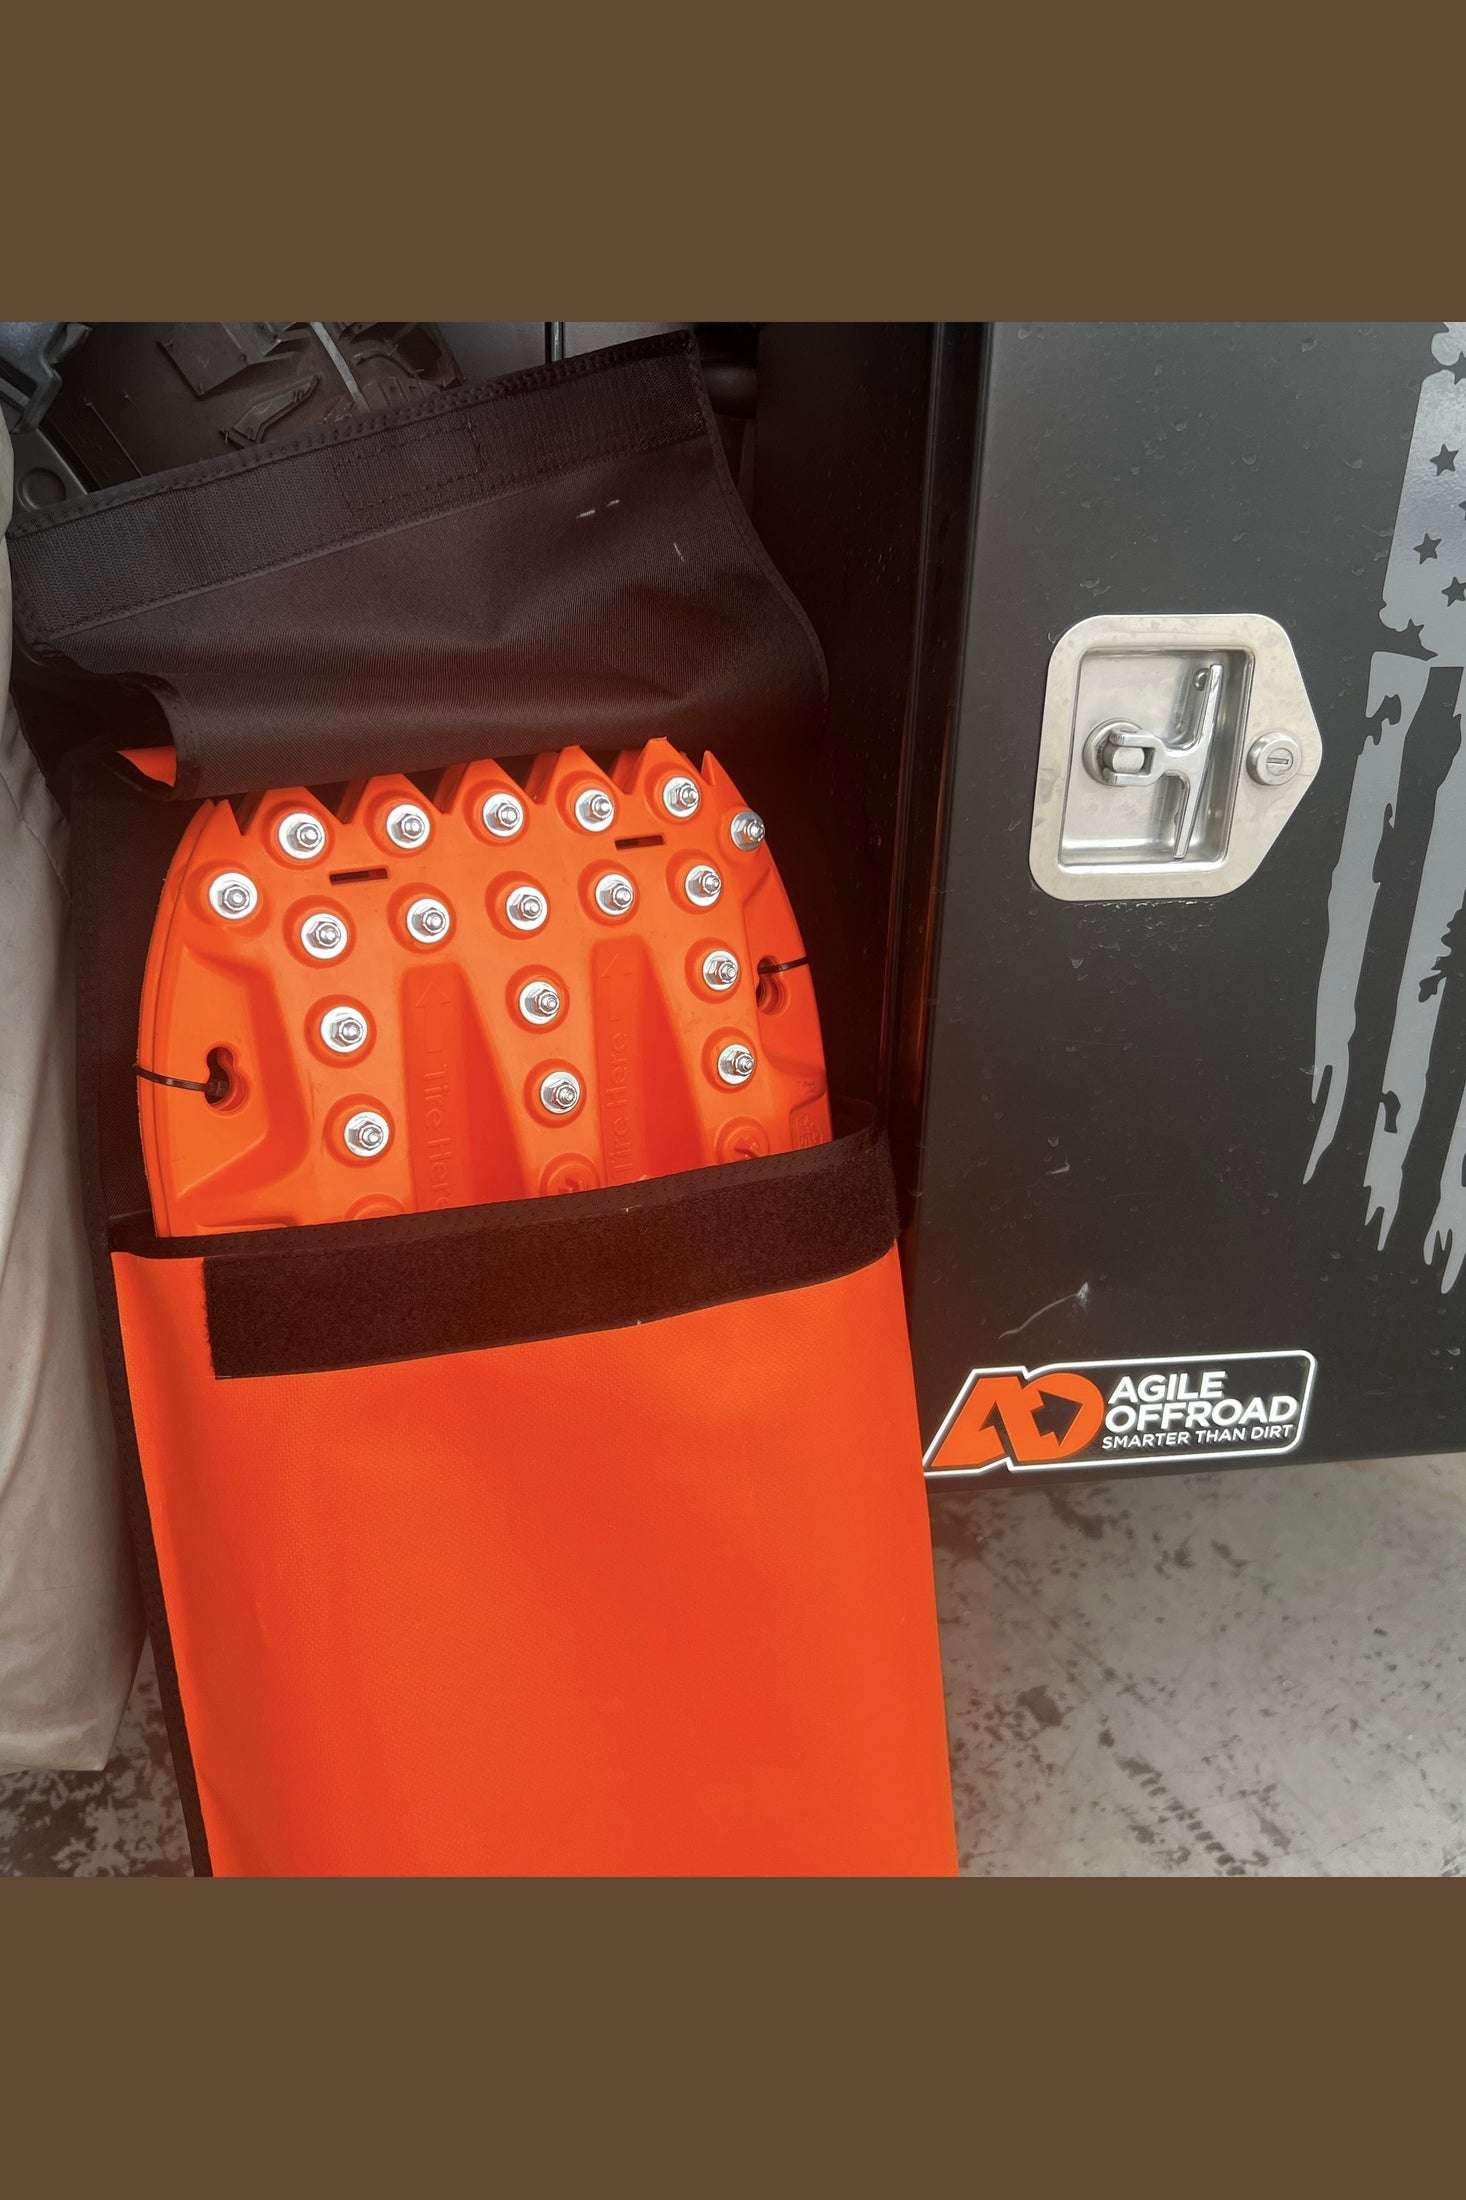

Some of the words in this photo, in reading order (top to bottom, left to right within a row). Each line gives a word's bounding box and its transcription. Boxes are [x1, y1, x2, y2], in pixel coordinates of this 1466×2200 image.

[1108, 1371, 1227, 1404] AGILE
[1105, 1395, 1298, 1433] OFFROAD
[1102, 1431, 1190, 1450] SMARTER
[1196, 1426, 1246, 1444] THAN
[1250, 1424, 1294, 1440] DIRT
